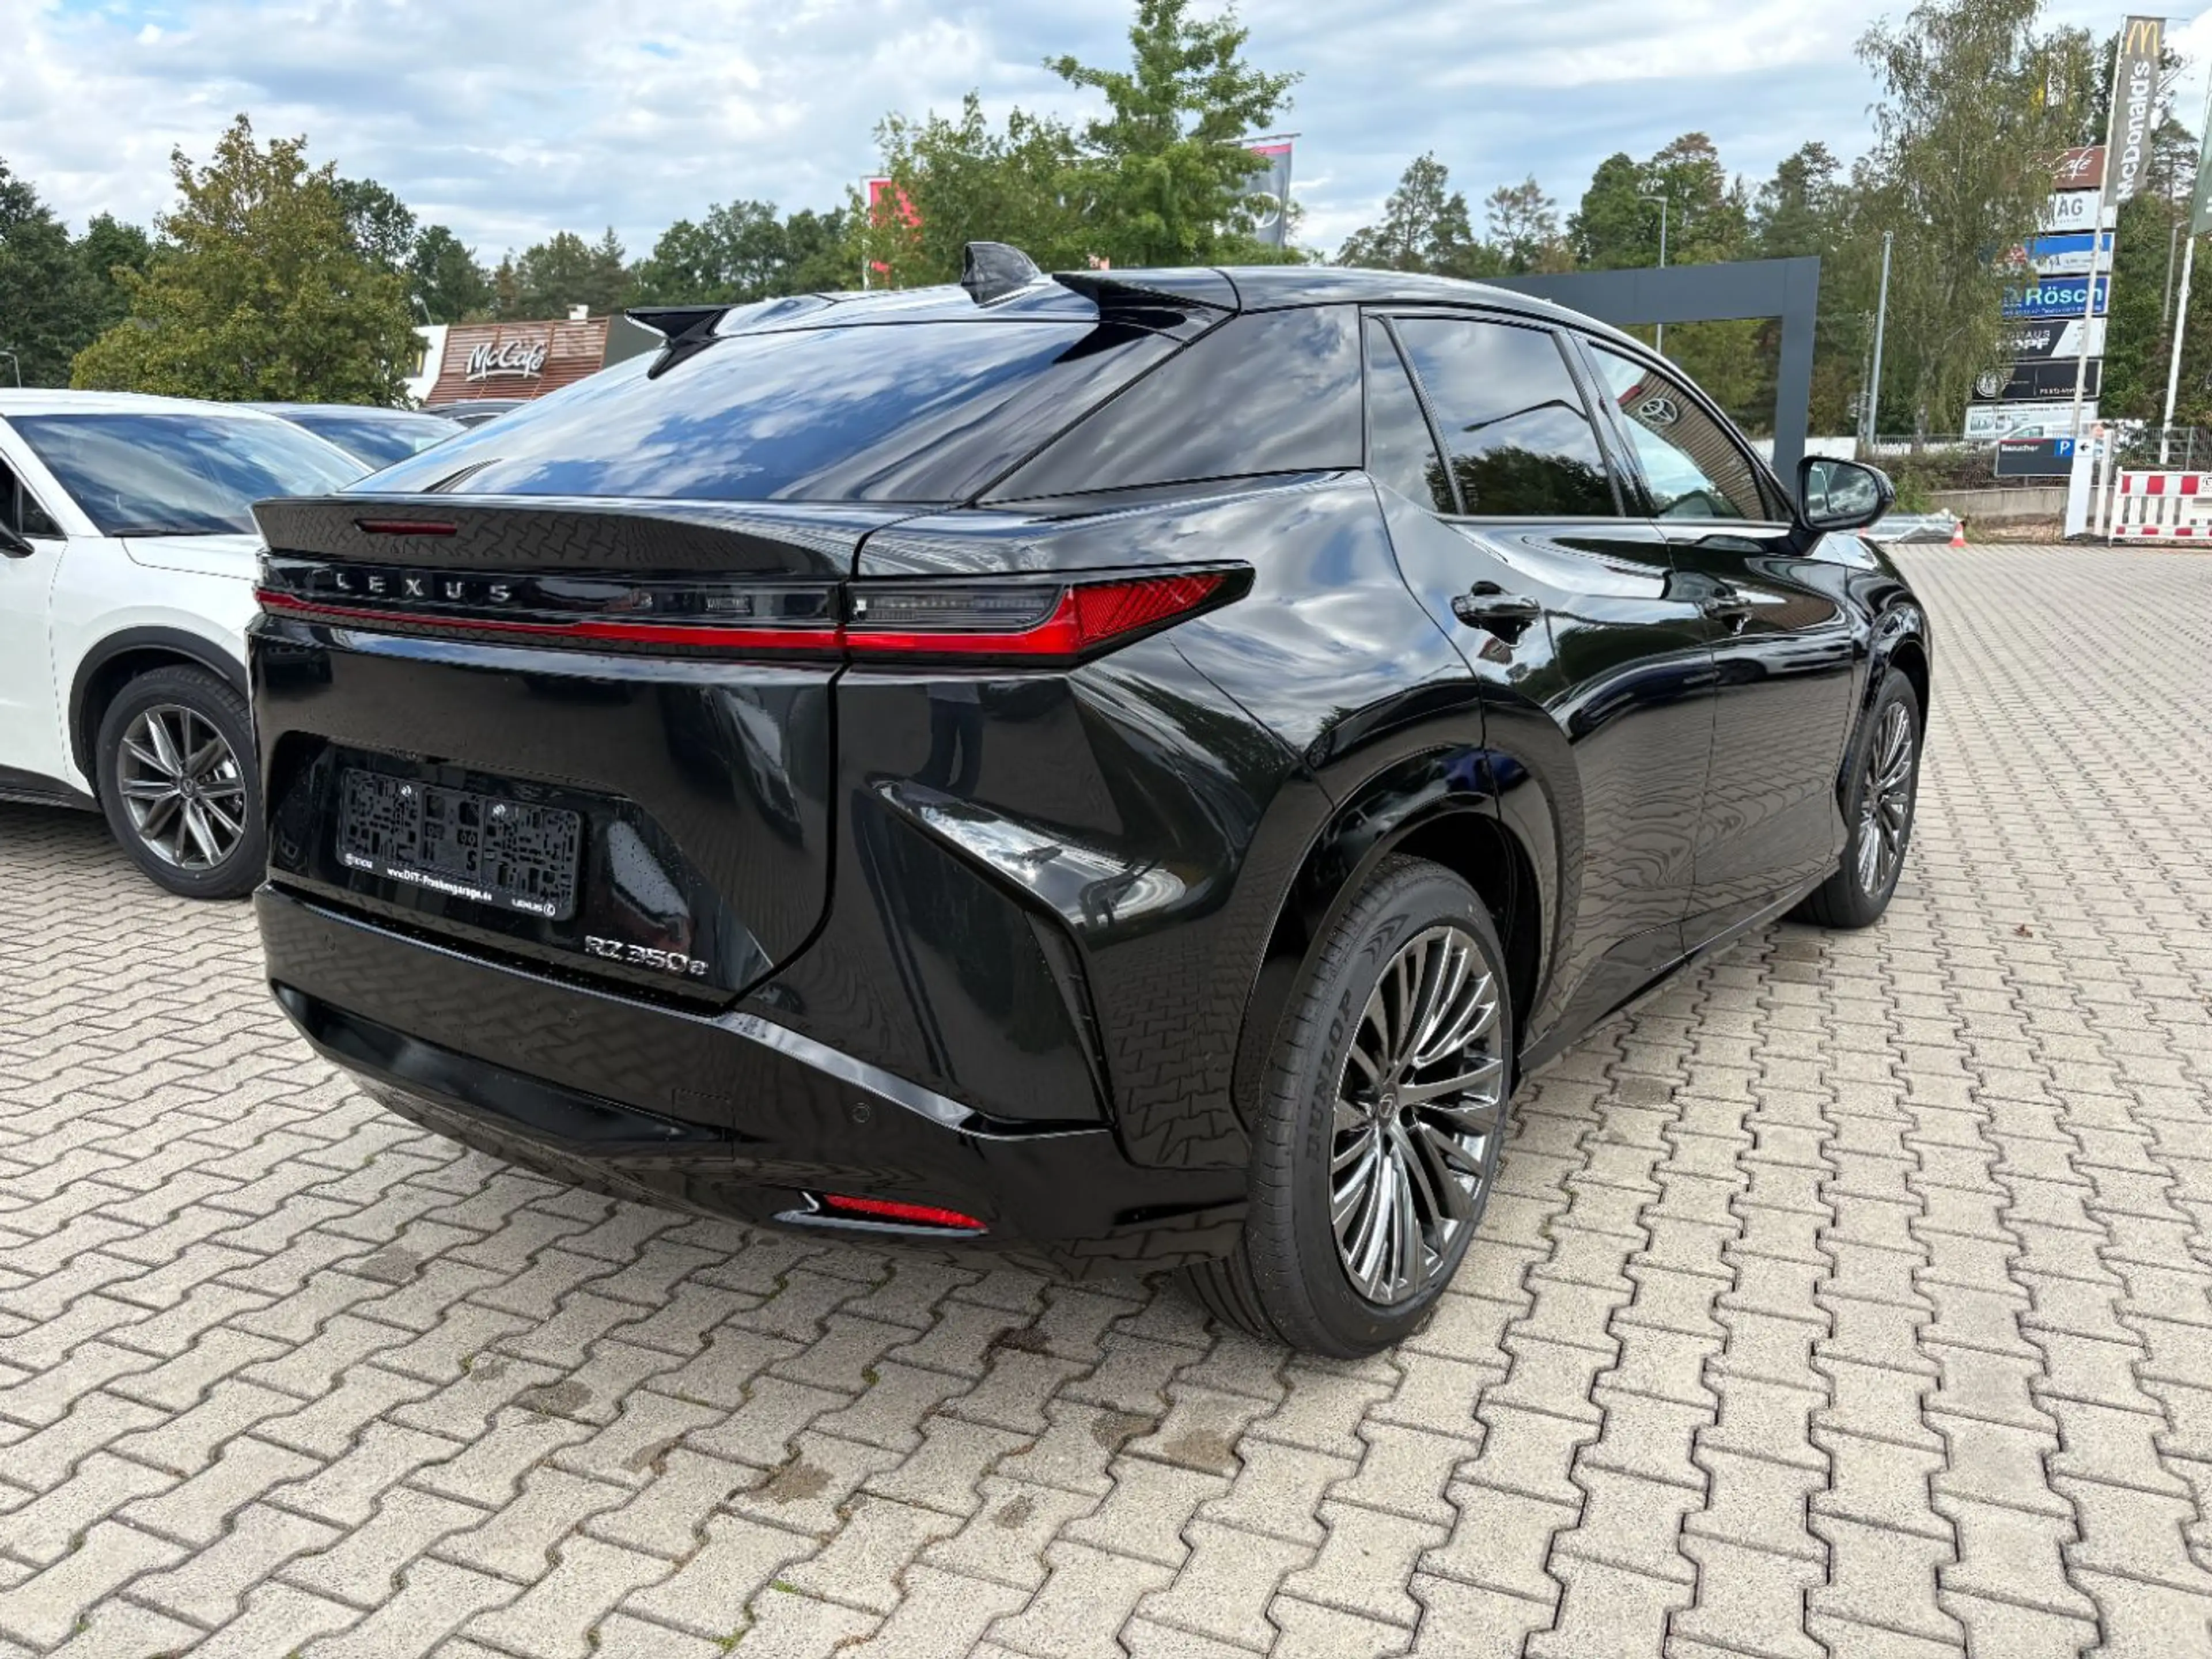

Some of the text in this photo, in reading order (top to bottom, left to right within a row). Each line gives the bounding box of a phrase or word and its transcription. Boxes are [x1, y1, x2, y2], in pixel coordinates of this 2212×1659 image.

[466, 342, 548, 381] McCafé
[335, 573, 513, 603] LEXUS
[585, 935, 624, 961] RZ
[1305, 988, 1352, 1164] DUNLOP
